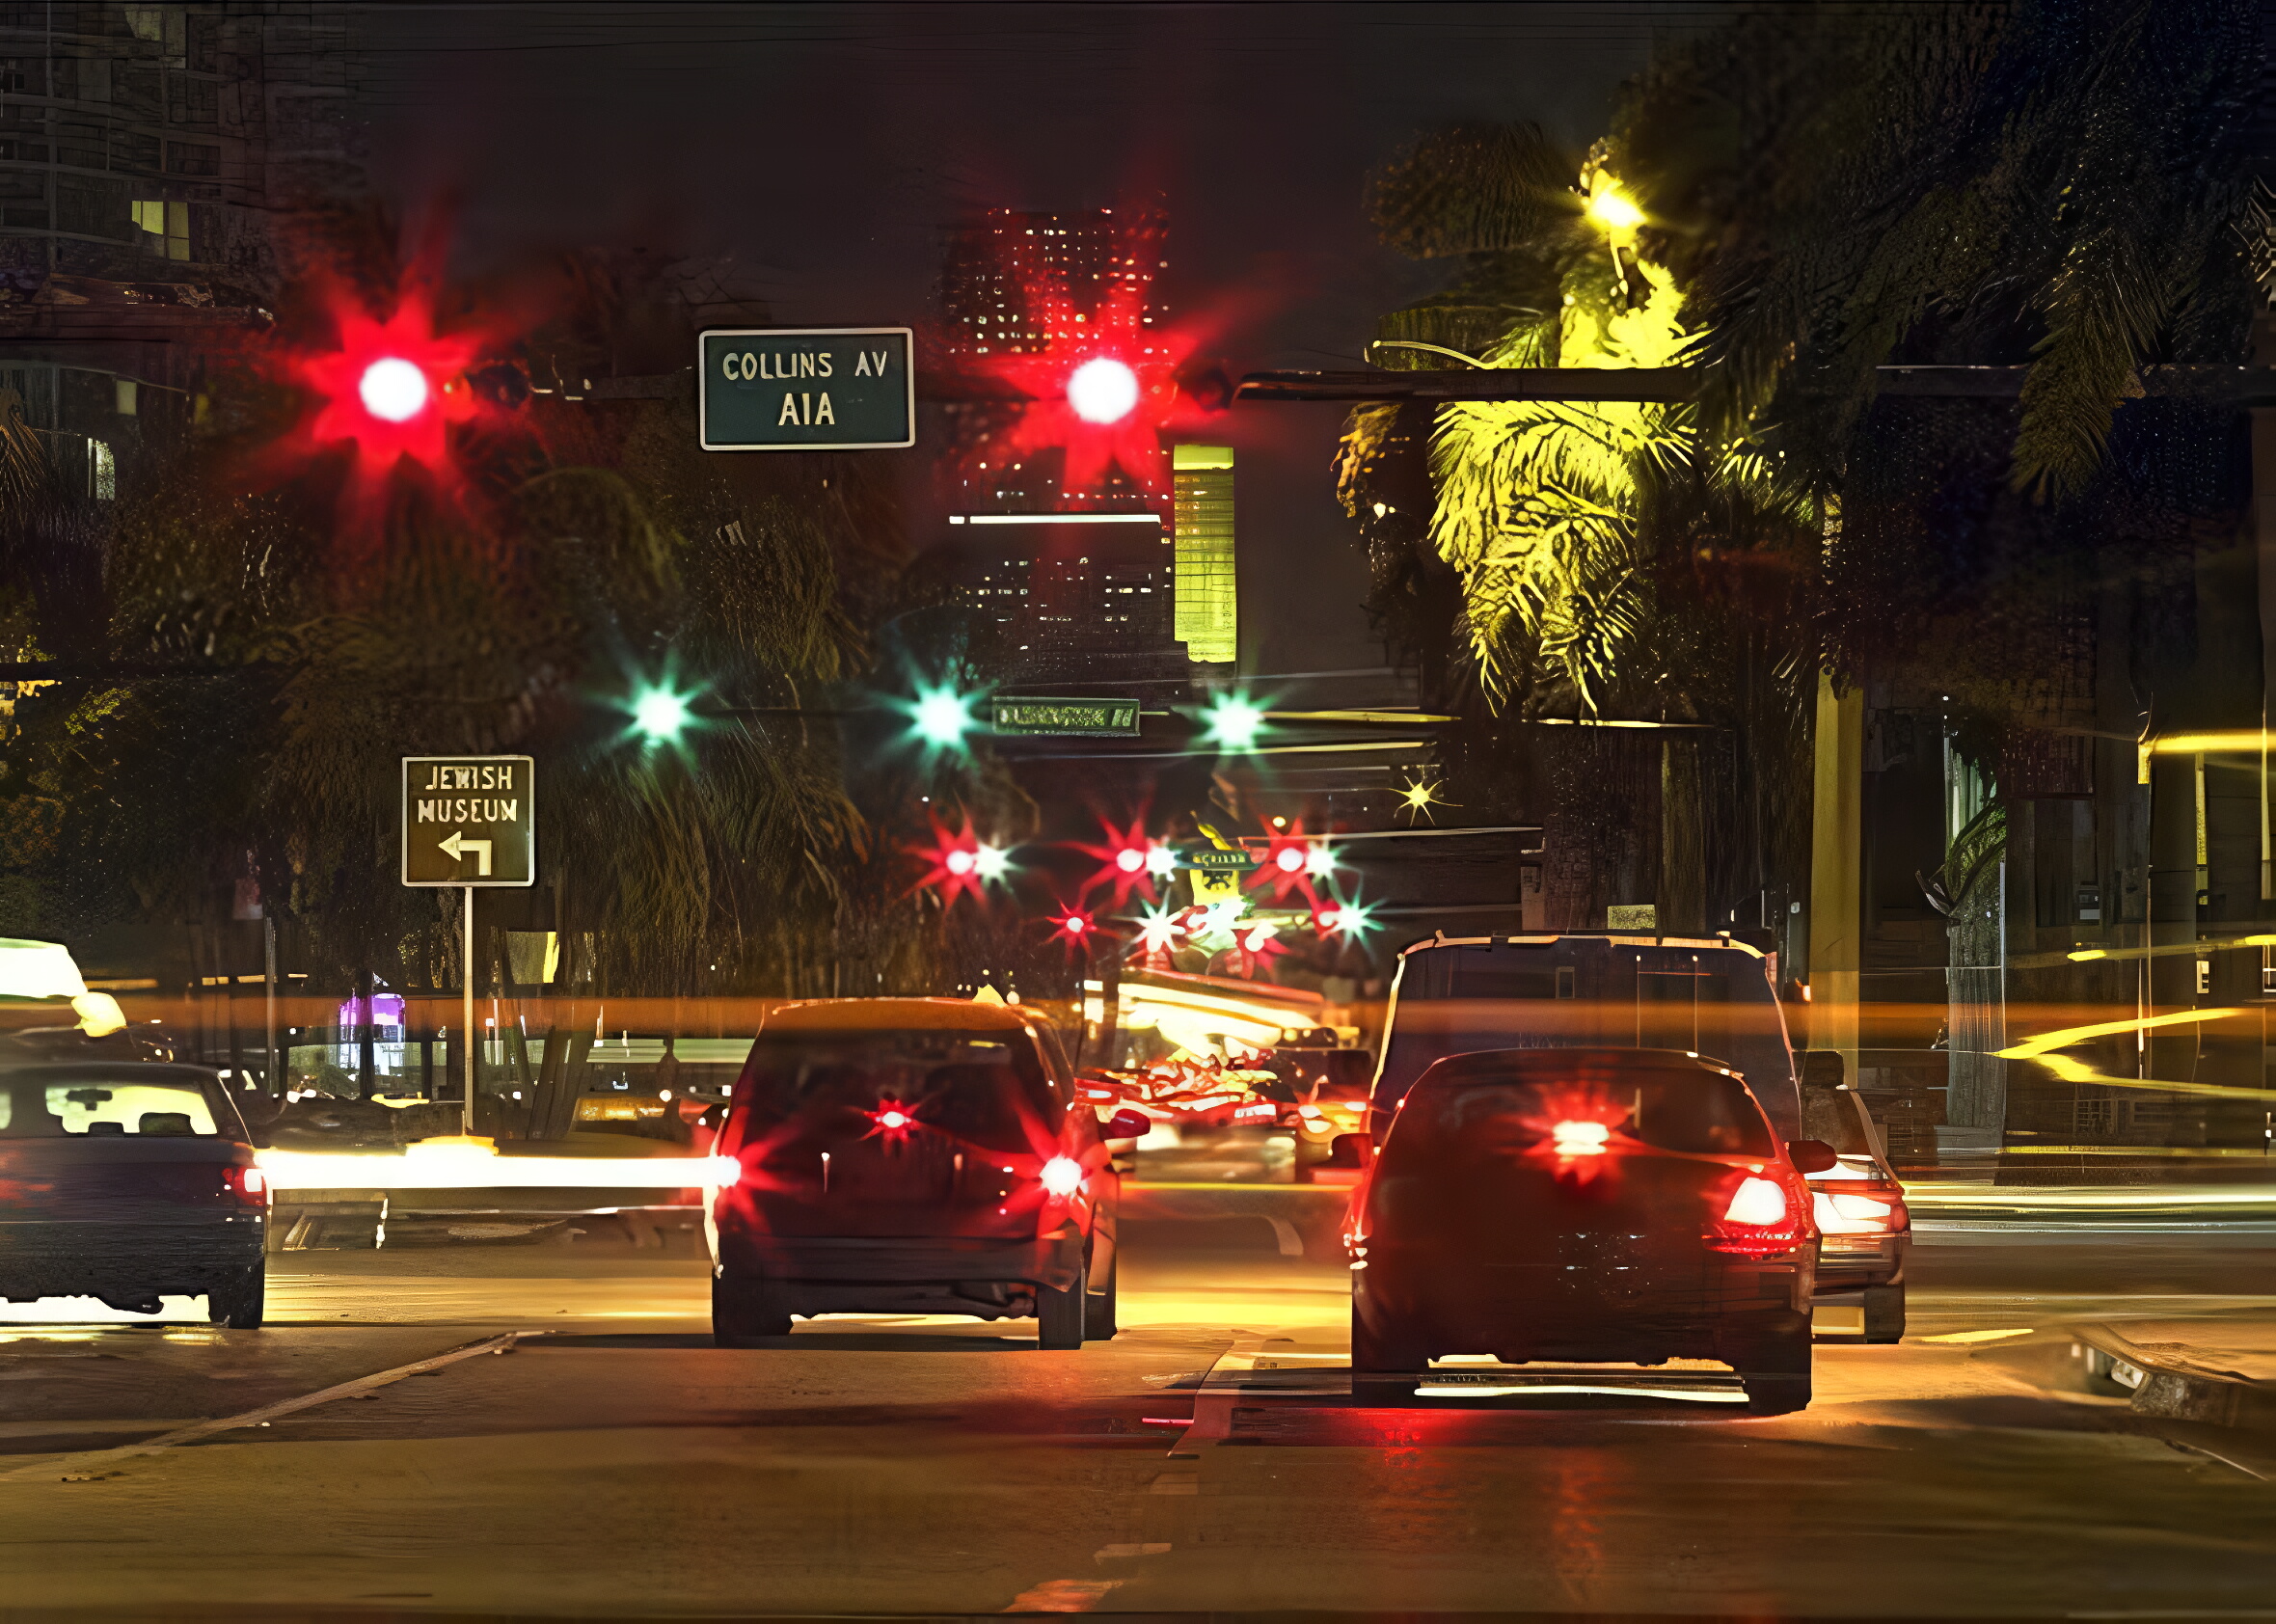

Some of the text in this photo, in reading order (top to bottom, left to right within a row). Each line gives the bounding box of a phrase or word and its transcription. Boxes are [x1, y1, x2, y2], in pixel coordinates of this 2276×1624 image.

[722, 351, 887, 381] COLLINS AV
[424, 766, 512, 791] JEWISH
[418, 798, 518, 824] MUSEUM
